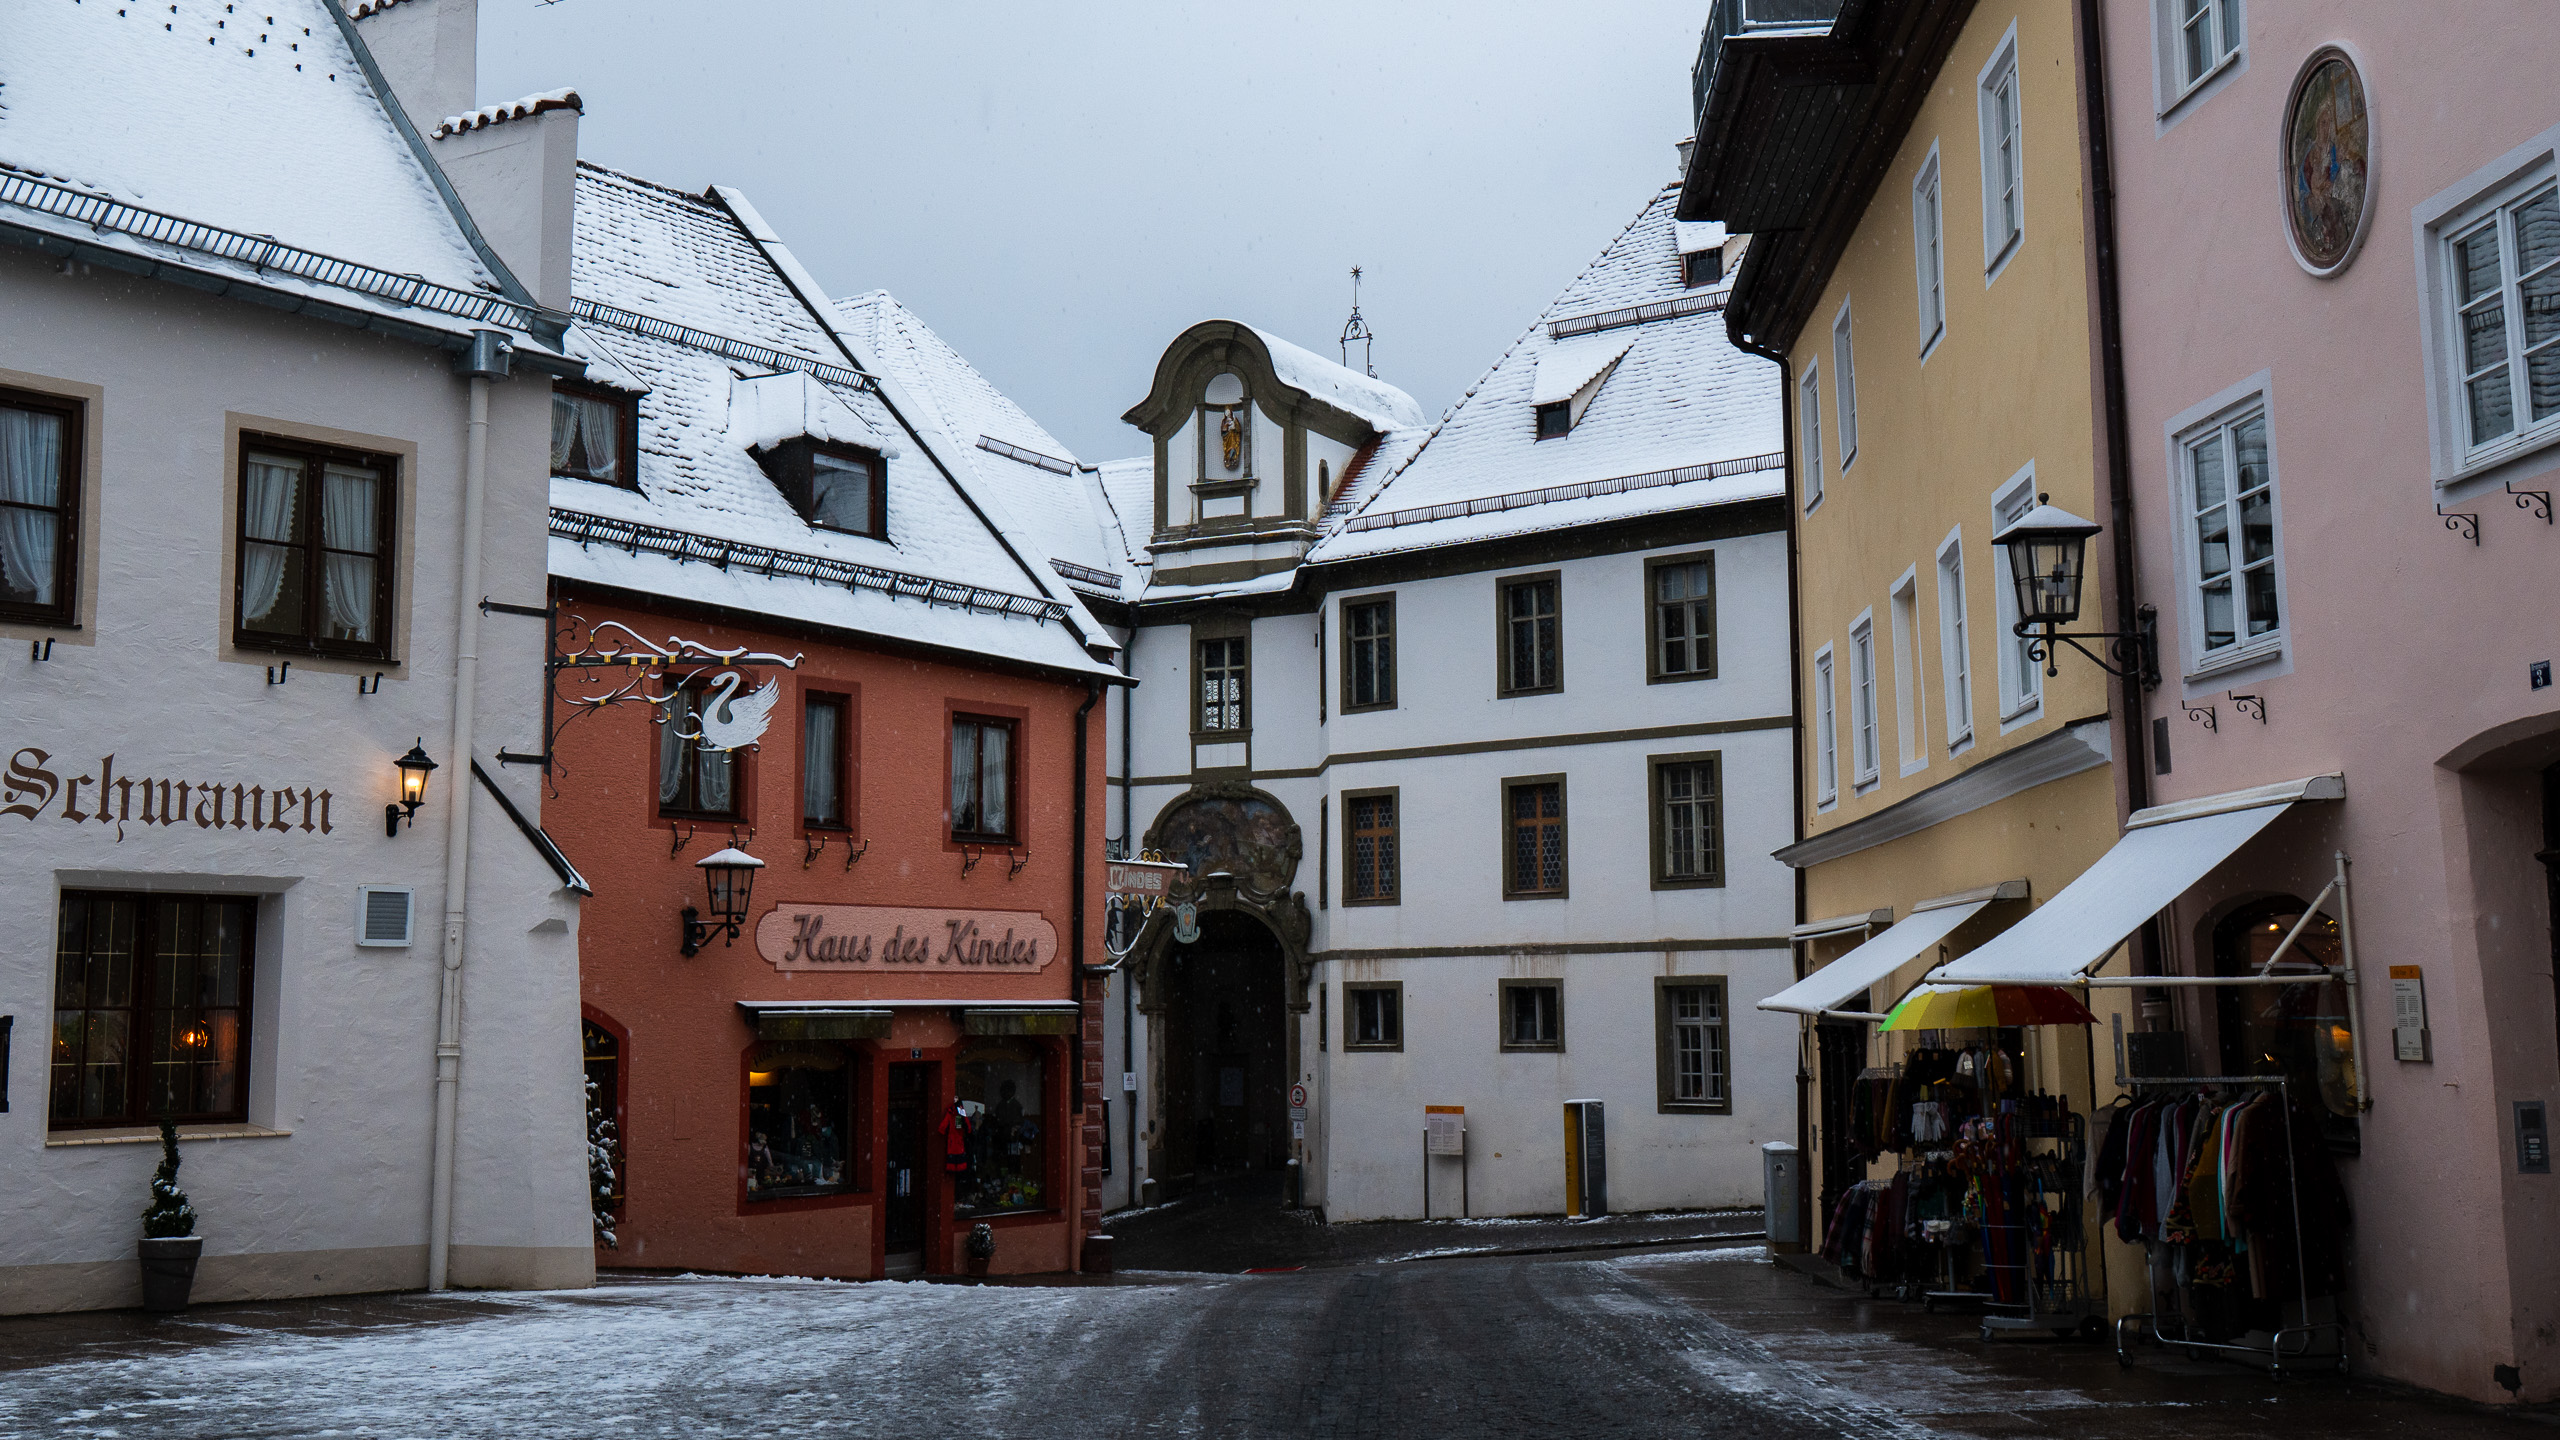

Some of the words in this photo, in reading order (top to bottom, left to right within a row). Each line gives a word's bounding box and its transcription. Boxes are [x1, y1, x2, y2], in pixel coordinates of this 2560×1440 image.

[2536, 669, 2544, 687] 3
[0, 747, 334, 843] Schwanen
[784, 913, 872, 963] Haus
[882, 924, 930, 964] des
[938, 919, 1038, 965] Kindes
[1306, 1073, 1312, 1081] 3
